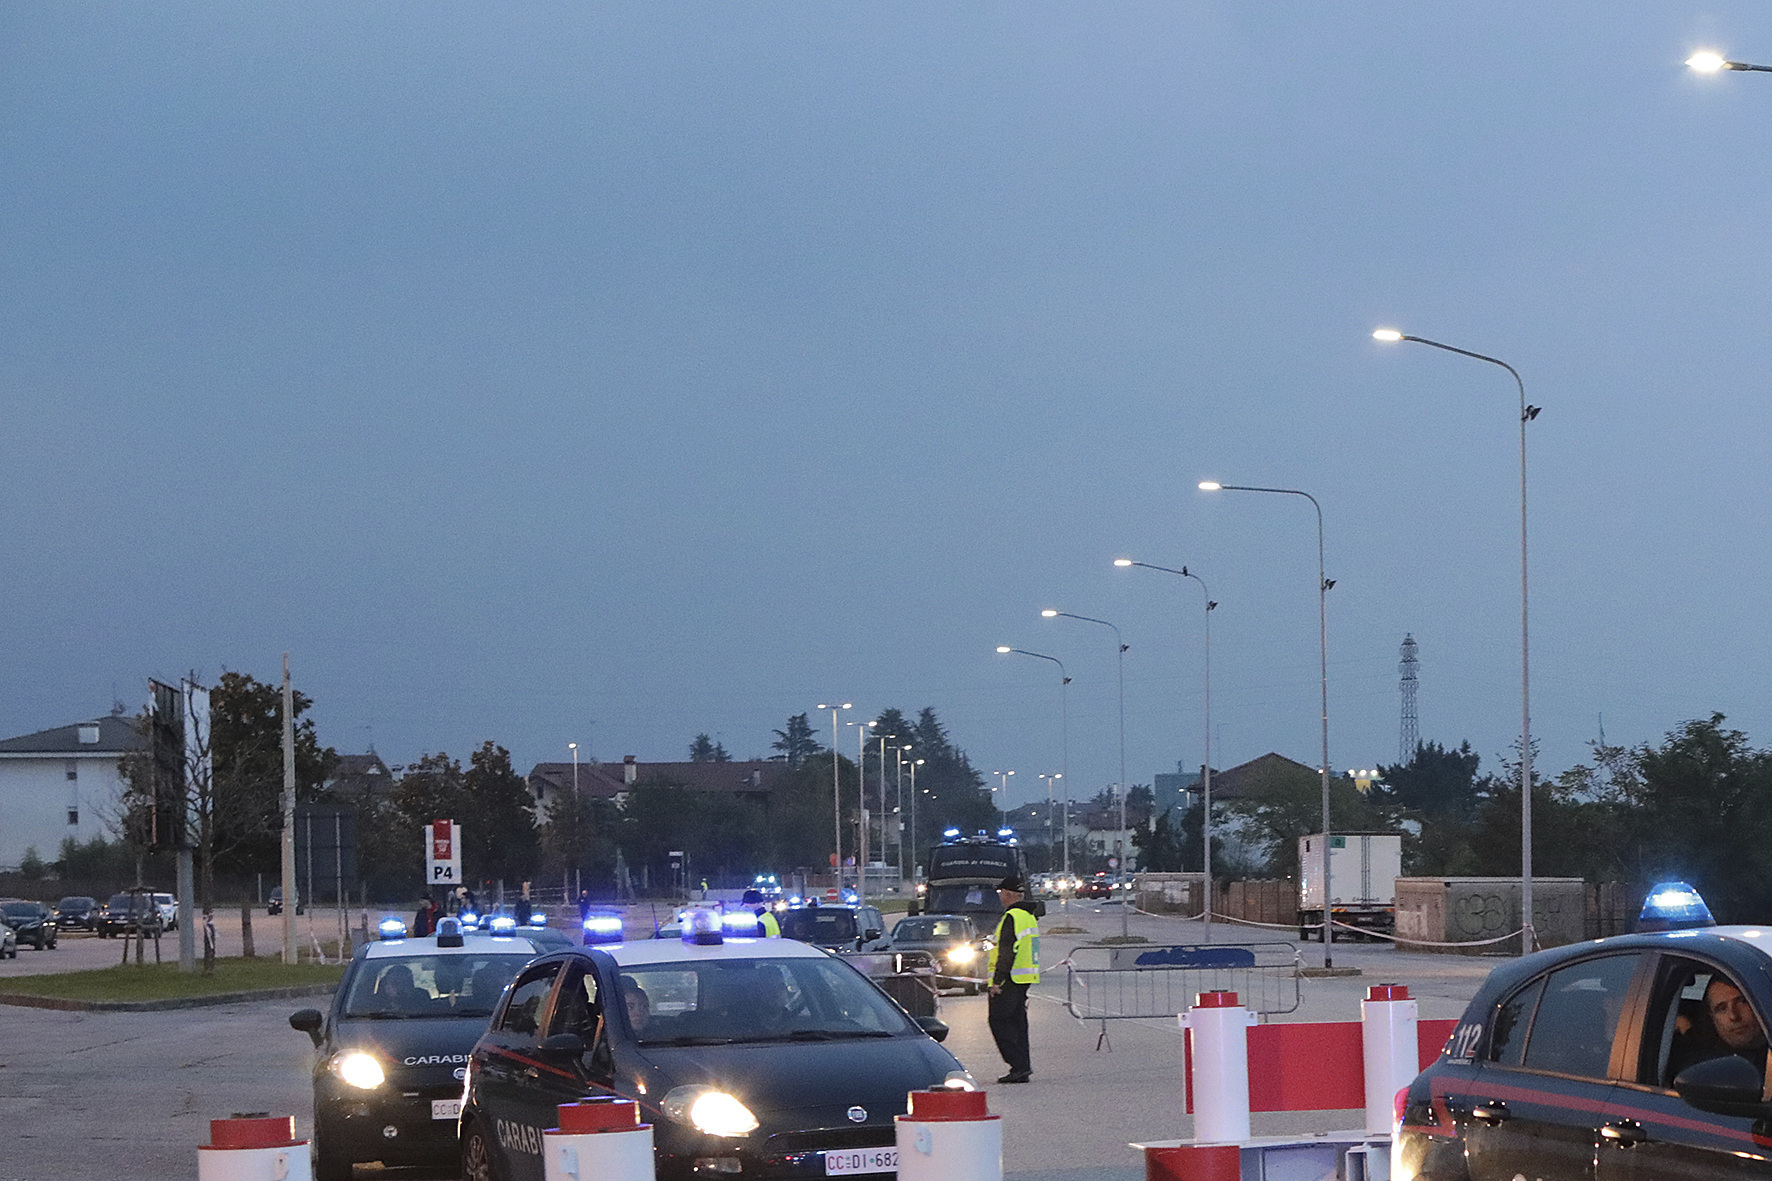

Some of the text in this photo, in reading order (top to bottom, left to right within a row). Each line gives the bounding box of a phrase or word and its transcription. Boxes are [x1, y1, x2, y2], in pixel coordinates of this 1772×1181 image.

[434, 866, 453, 880] P4
[1453, 1024, 1482, 1058] 112
[404, 1054, 468, 1066] CARABI
[434, 1105, 447, 1115] CC
[496, 1118, 544, 1156] CARABI
[827, 1156, 844, 1170] CC
[875, 1152, 898, 1167] 682
